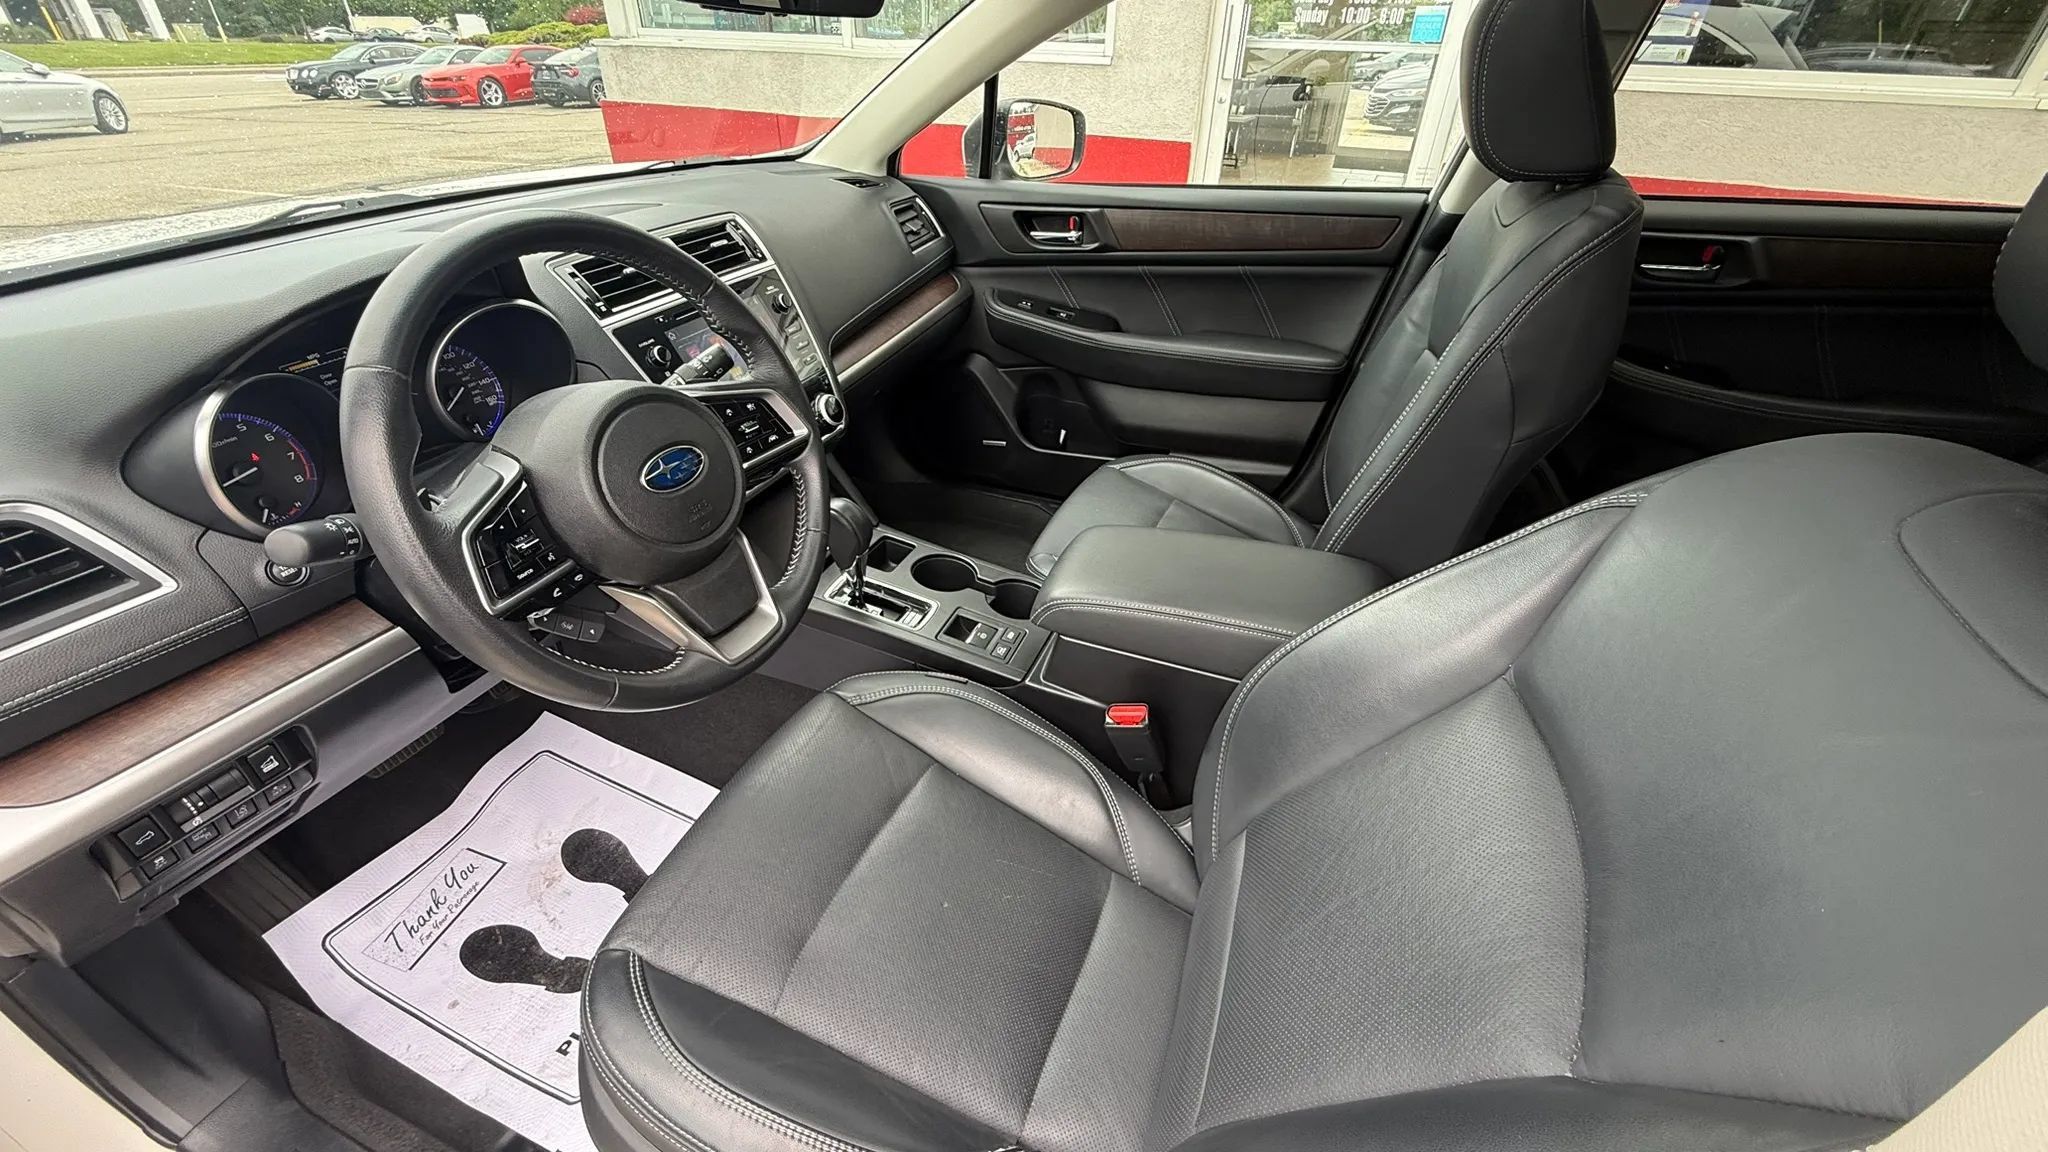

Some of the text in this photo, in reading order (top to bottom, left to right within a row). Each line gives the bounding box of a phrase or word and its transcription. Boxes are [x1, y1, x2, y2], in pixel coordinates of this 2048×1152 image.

[1295, 6, 1329, 26] Sunday
[1341, 6, 1371, 24] 10:00
[265, 432, 275, 442] 6
[287, 451, 295, 460] 7
[294, 474, 305, 483] 8
[384, 863, 480, 953] Thank You
[419, 931, 433, 946] For
[432, 914, 449, 930] Your
